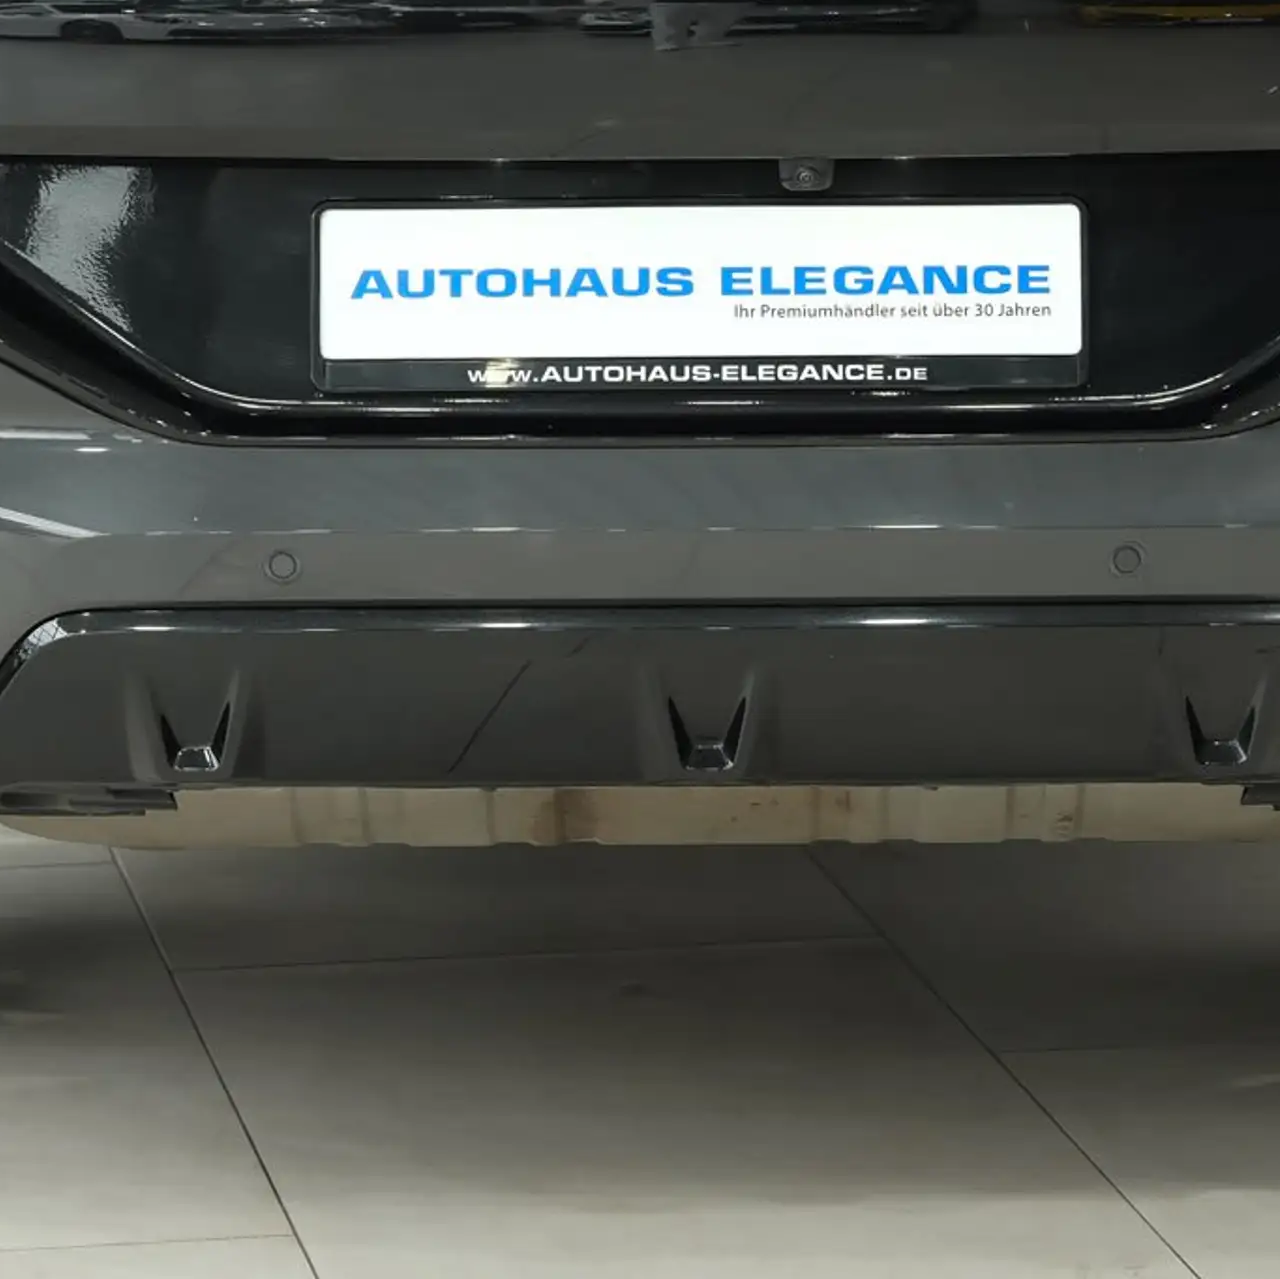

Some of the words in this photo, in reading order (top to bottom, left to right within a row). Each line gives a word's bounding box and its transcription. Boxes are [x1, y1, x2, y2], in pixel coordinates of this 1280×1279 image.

[350, 266, 695, 299] AUTOHAUS
[720, 264, 1052, 296] ELEGANCE
[733, 303, 756, 319] Ihr
[760, 303, 895, 319] Premiumhändler
[900, 303, 928, 318] seit
[932, 303, 970, 318] über
[974, 302, 995, 317] 30
[998, 302, 1052, 318] Jahren
[467, 363, 928, 383] ww.AUTOHAUS-ELEGANCE.DE
